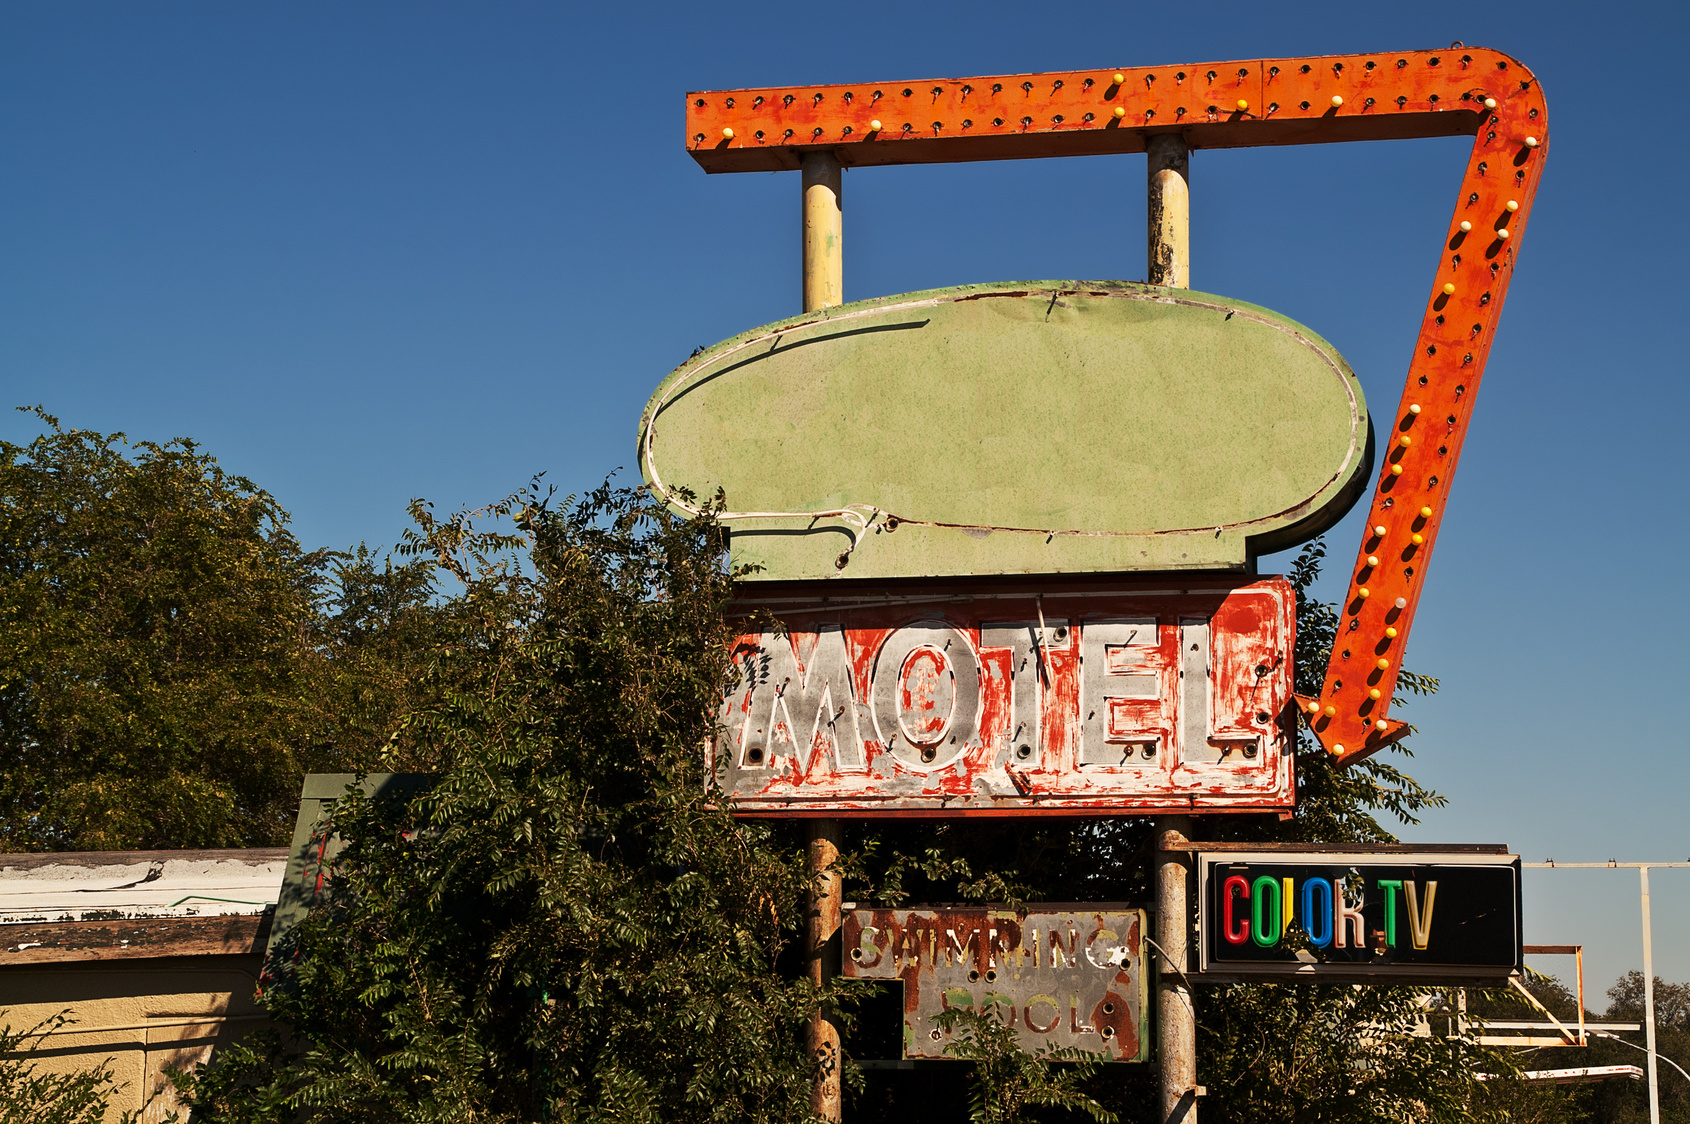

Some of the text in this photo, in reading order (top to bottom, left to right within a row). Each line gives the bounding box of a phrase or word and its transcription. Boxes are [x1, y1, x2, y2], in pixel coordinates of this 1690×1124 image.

[738, 618, 1264, 771] MOTEL
[852, 925, 1132, 970] SWIMMING
[1223, 874, 1438, 950] COLOR TV
